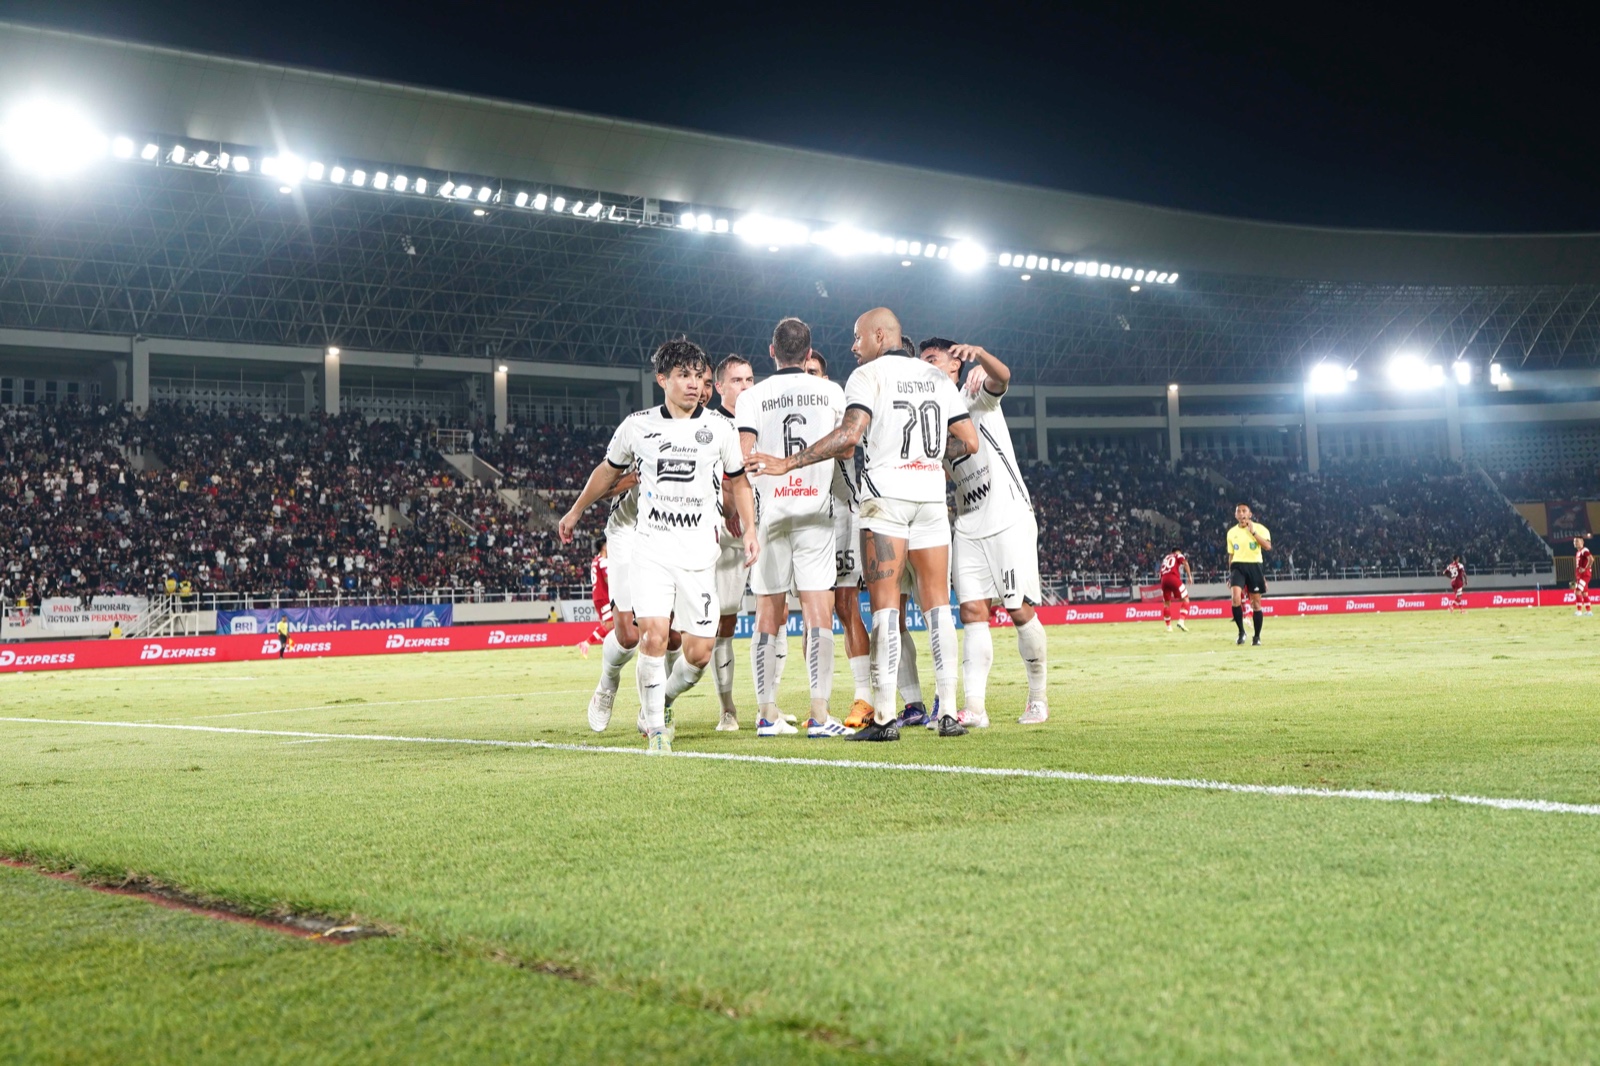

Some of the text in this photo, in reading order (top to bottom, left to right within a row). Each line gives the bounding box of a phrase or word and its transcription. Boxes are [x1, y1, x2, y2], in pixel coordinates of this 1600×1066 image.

[897, 381, 936, 394] GUSTAVO
[762, 394, 829, 412] RAMÓN BUENO
[893, 400, 941, 460] 70
[783, 413, 808, 459] 6
[789, 476, 803, 487] Le
[774, 486, 819, 498] Minerale
[660, 495, 684, 503] TRUST
[53, 603, 131, 613] PAIN IS MPORARY
[702, 593, 712, 617] 7
[82, 613, 90, 622] IS
[1136, 610, 1161, 618] EXPRESS
[234, 621, 253, 632] BRI
[266, 620, 347, 633] FNtastic
[351, 618, 415, 630] Football
[404, 637, 450, 647] EXPRESS
[505, 633, 548, 643] EXPRESS
[162, 647, 217, 658] EXPRESS
[15, 653, 75, 665] EXPRESS
